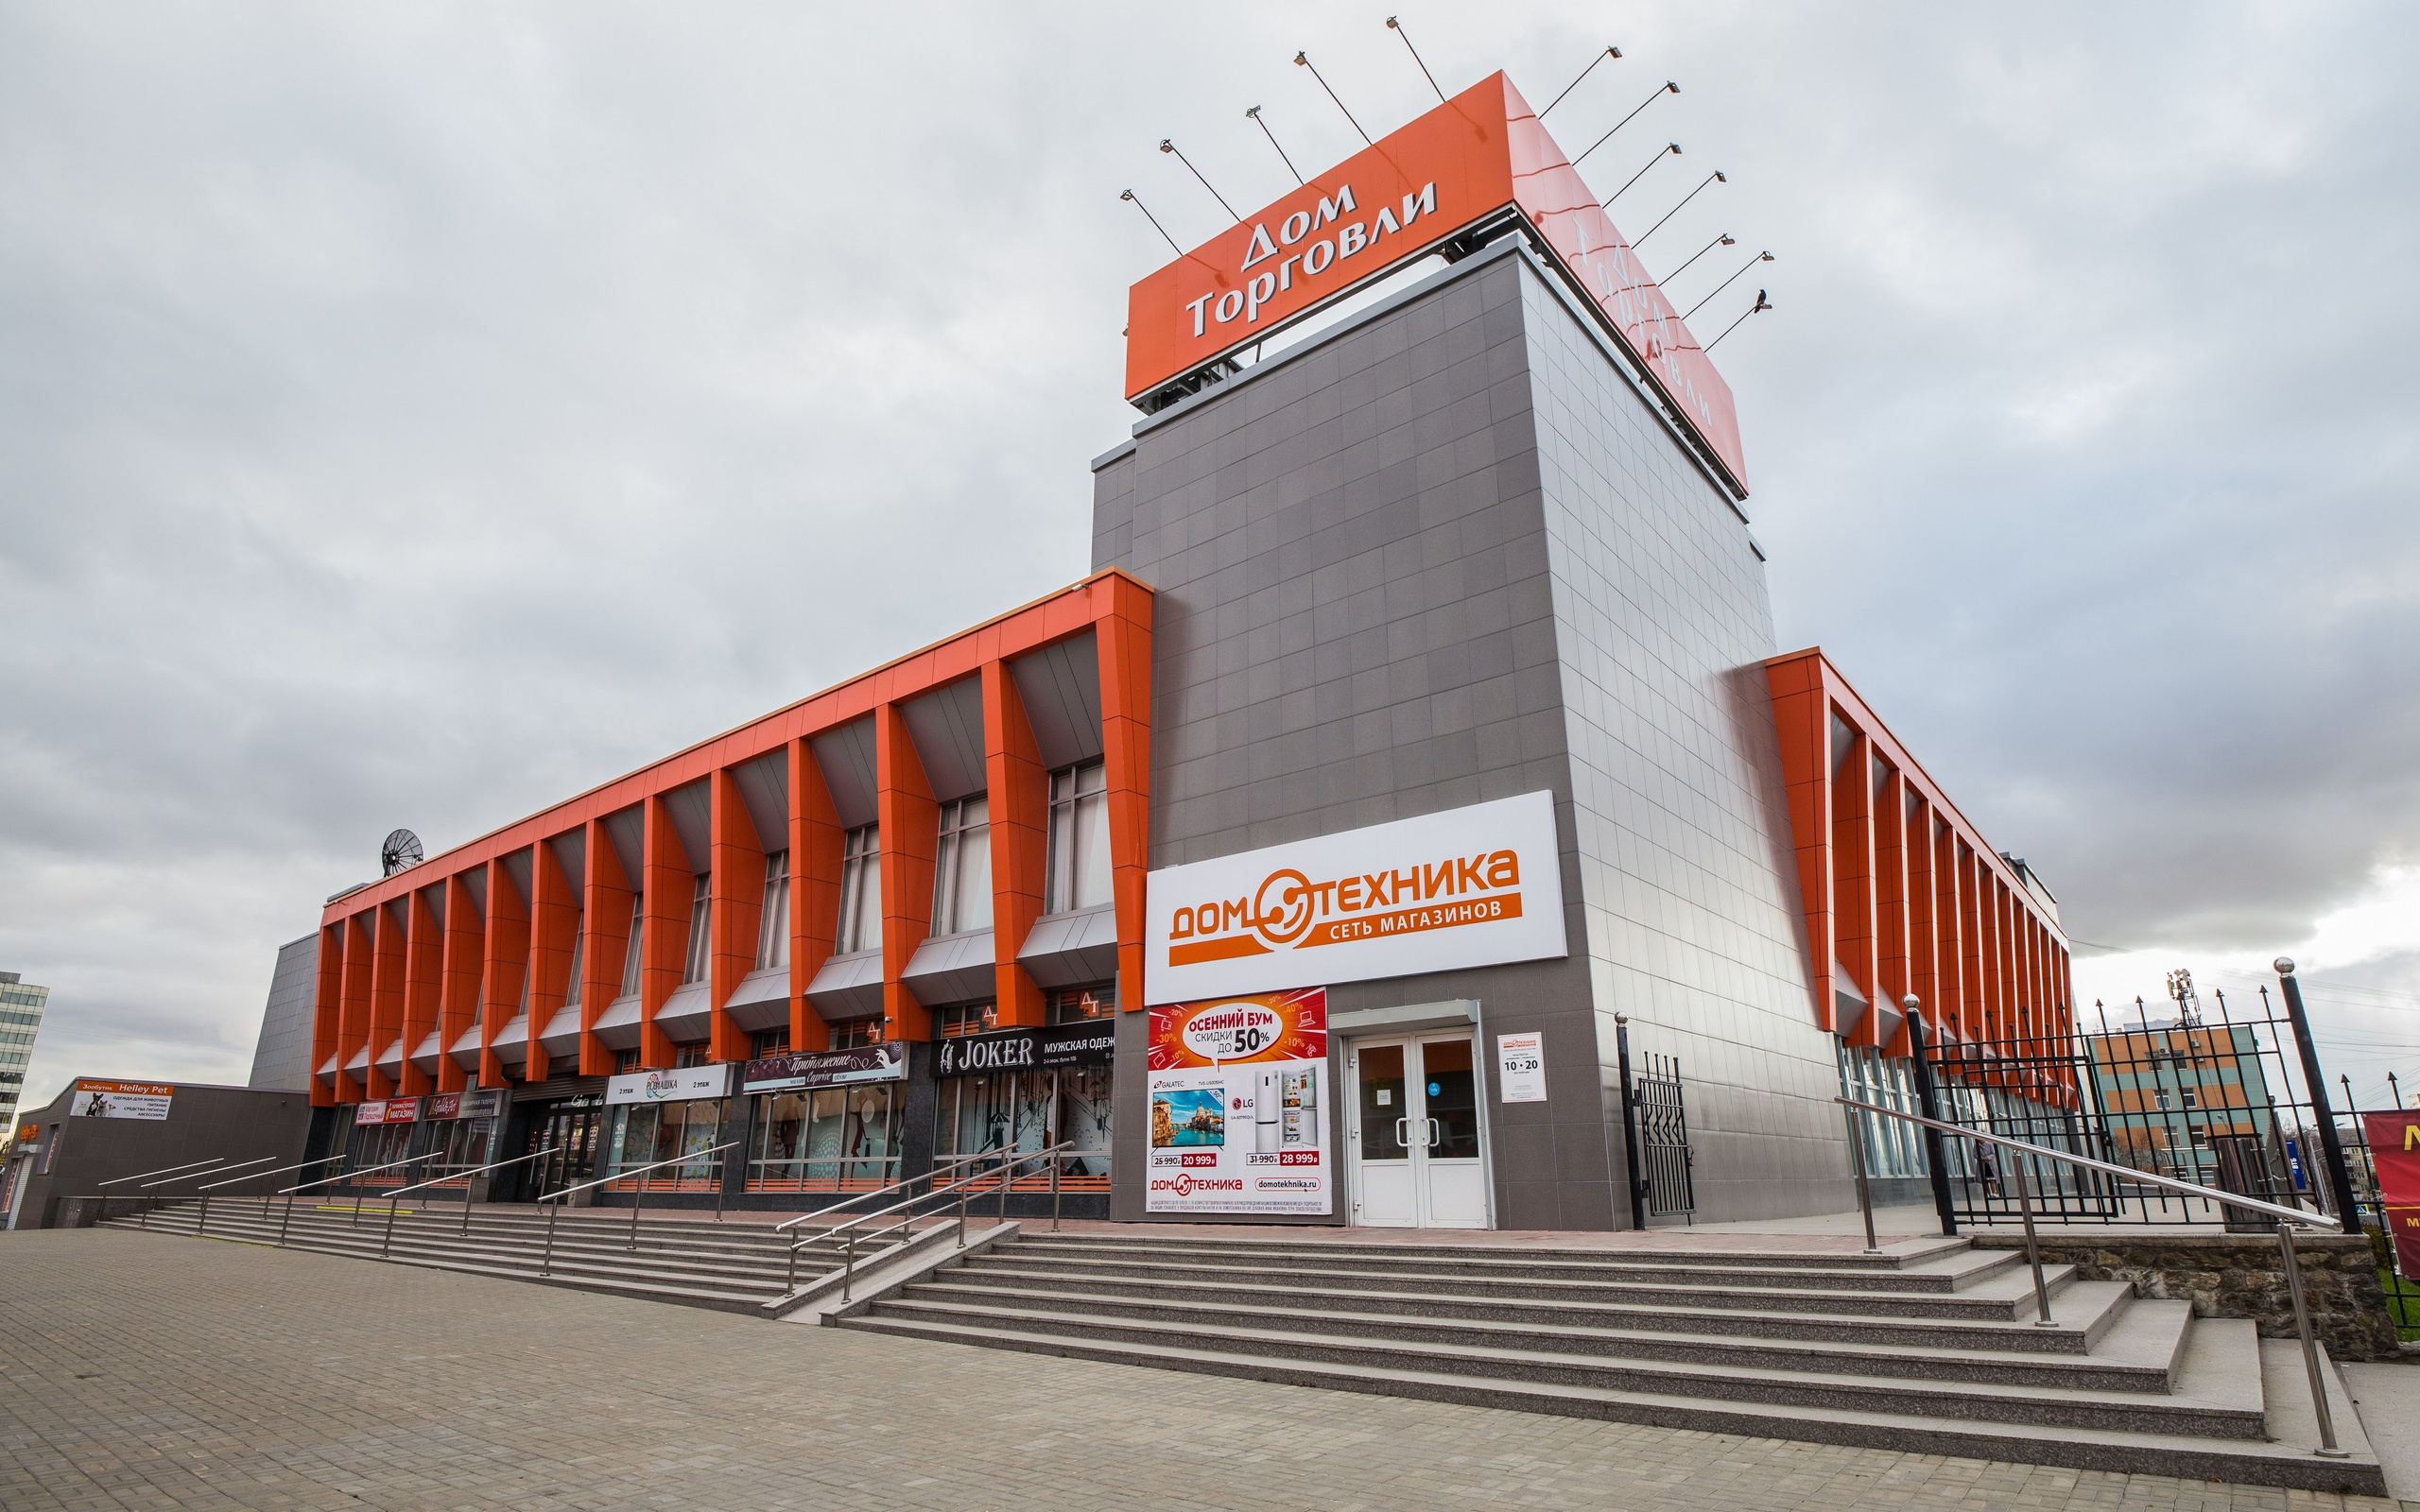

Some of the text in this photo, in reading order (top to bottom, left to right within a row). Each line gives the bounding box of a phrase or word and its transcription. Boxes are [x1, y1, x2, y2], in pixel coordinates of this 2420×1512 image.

[1241, 184, 1357, 272] Дом
[1186, 182, 1438, 337] Торговли
[1613, 241, 1670, 342] Дом
[1572, 216, 1712, 427] Торговли
[1329, 901, 1502, 940] СЕТЬ МАГАЗИНОВ
[1267, 994, 1281, 1005] -20%
[1168, 1008, 1184, 1017] -20%
[1283, 1003, 1304, 1014] -40%
[1188, 1008, 1273, 1033] ОСЕННИЙ БУМ
[1156, 1033, 1177, 1043] -30%
[1195, 1031, 1233, 1042] СКИДКИ
[1218, 1027, 1270, 1055] ДО 50%
[1045, 1040, 1087, 1054] МУЖСКАЯ
[1283, 1038, 1305, 1048] -10%
[959, 1038, 1034, 1070] JOKER
[791, 1055, 851, 1075] Притяжение
[1505, 1060, 1538, 1071] 10 20
[119, 1084, 149, 1093] Helley
[1243, 1099, 1253, 1108] LG
[389, 1110, 414, 1119] МАГАЗИН
[1184, 1156, 1195, 1165] 20
[1282, 1154, 1294, 1163] 28
[2290, 1158, 2299, 1169] ВТБ
[1258, 1179, 1317, 1189] domotekhnika.ru
